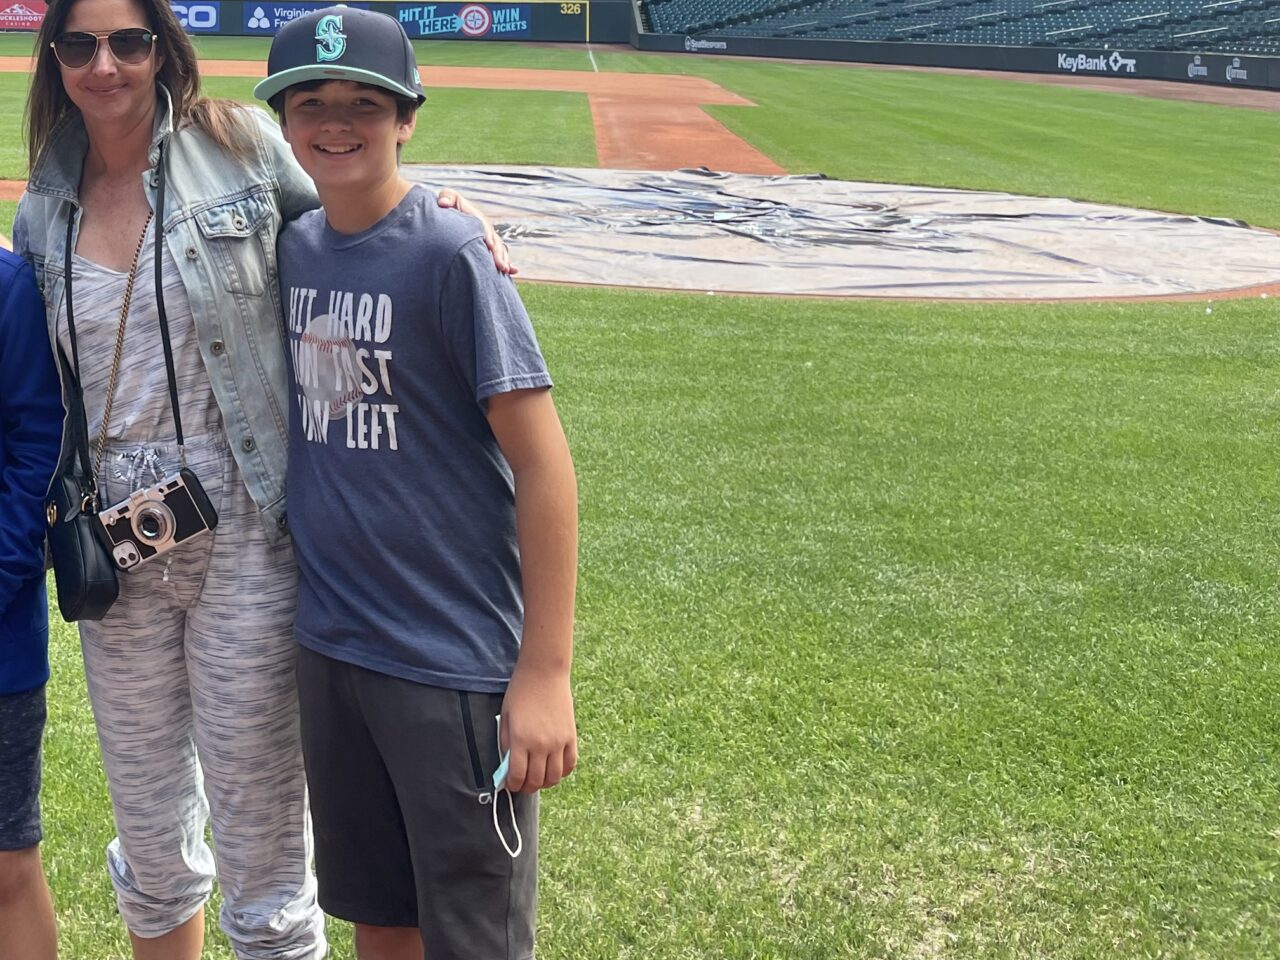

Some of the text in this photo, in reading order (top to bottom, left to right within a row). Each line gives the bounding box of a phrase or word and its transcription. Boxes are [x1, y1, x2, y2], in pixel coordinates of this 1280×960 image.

[399, 5, 437, 23] HIT IT
[492, 8, 520, 24] WIN
[560, 4, 581, 15] 326
[422, 17, 457, 31] HERE
[492, 20, 527, 33] TICKETS
[1058, 53, 1107, 72] KeyBank
[1226, 64, 1247, 81] Corona
[289, 287, 393, 344] HIT HARD
[290, 339, 393, 396] UN FAST
[346, 403, 399, 451] LEFT
